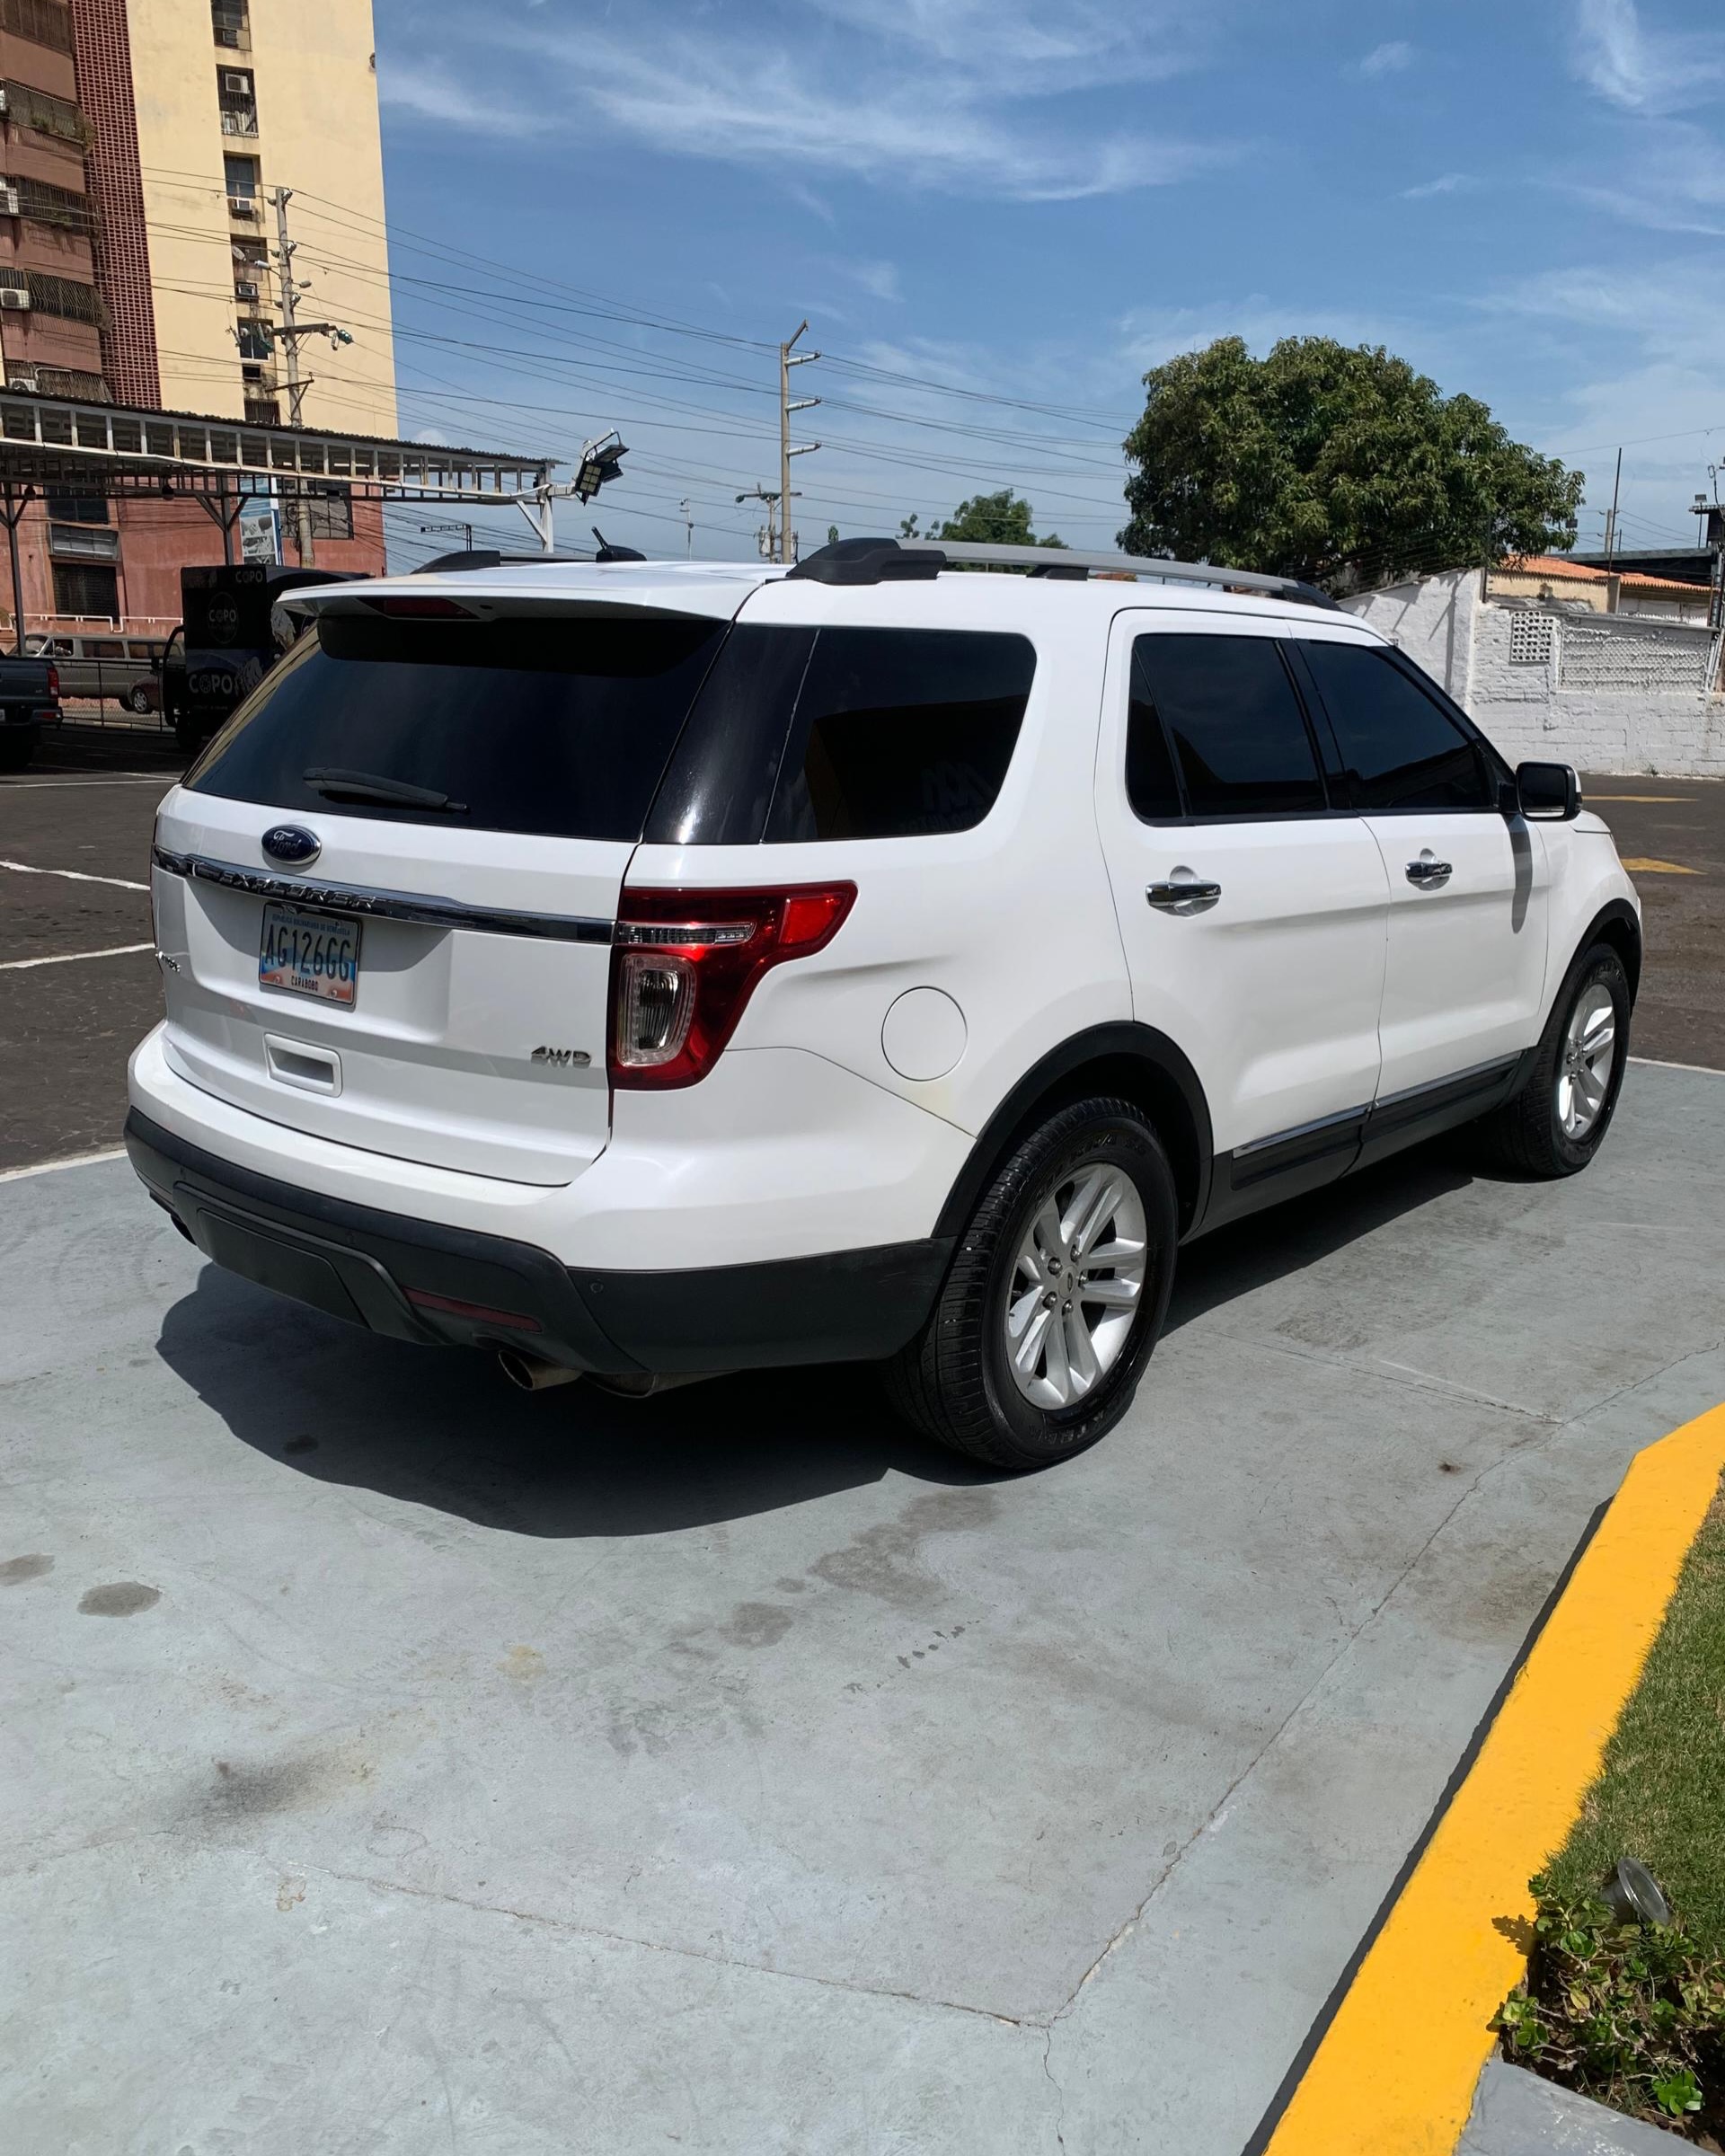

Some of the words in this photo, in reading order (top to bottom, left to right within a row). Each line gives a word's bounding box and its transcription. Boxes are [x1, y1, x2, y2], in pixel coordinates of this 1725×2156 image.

[235, 570, 263, 584] COPO
[208, 609, 237, 623] COPO
[268, 829, 302, 856] Ford
[218, 869, 376, 909] EXPLORER
[265, 924, 351, 982] AG126GG
[291, 976, 319, 992] CARABOBO
[531, 1046, 591, 1065] 4WD
